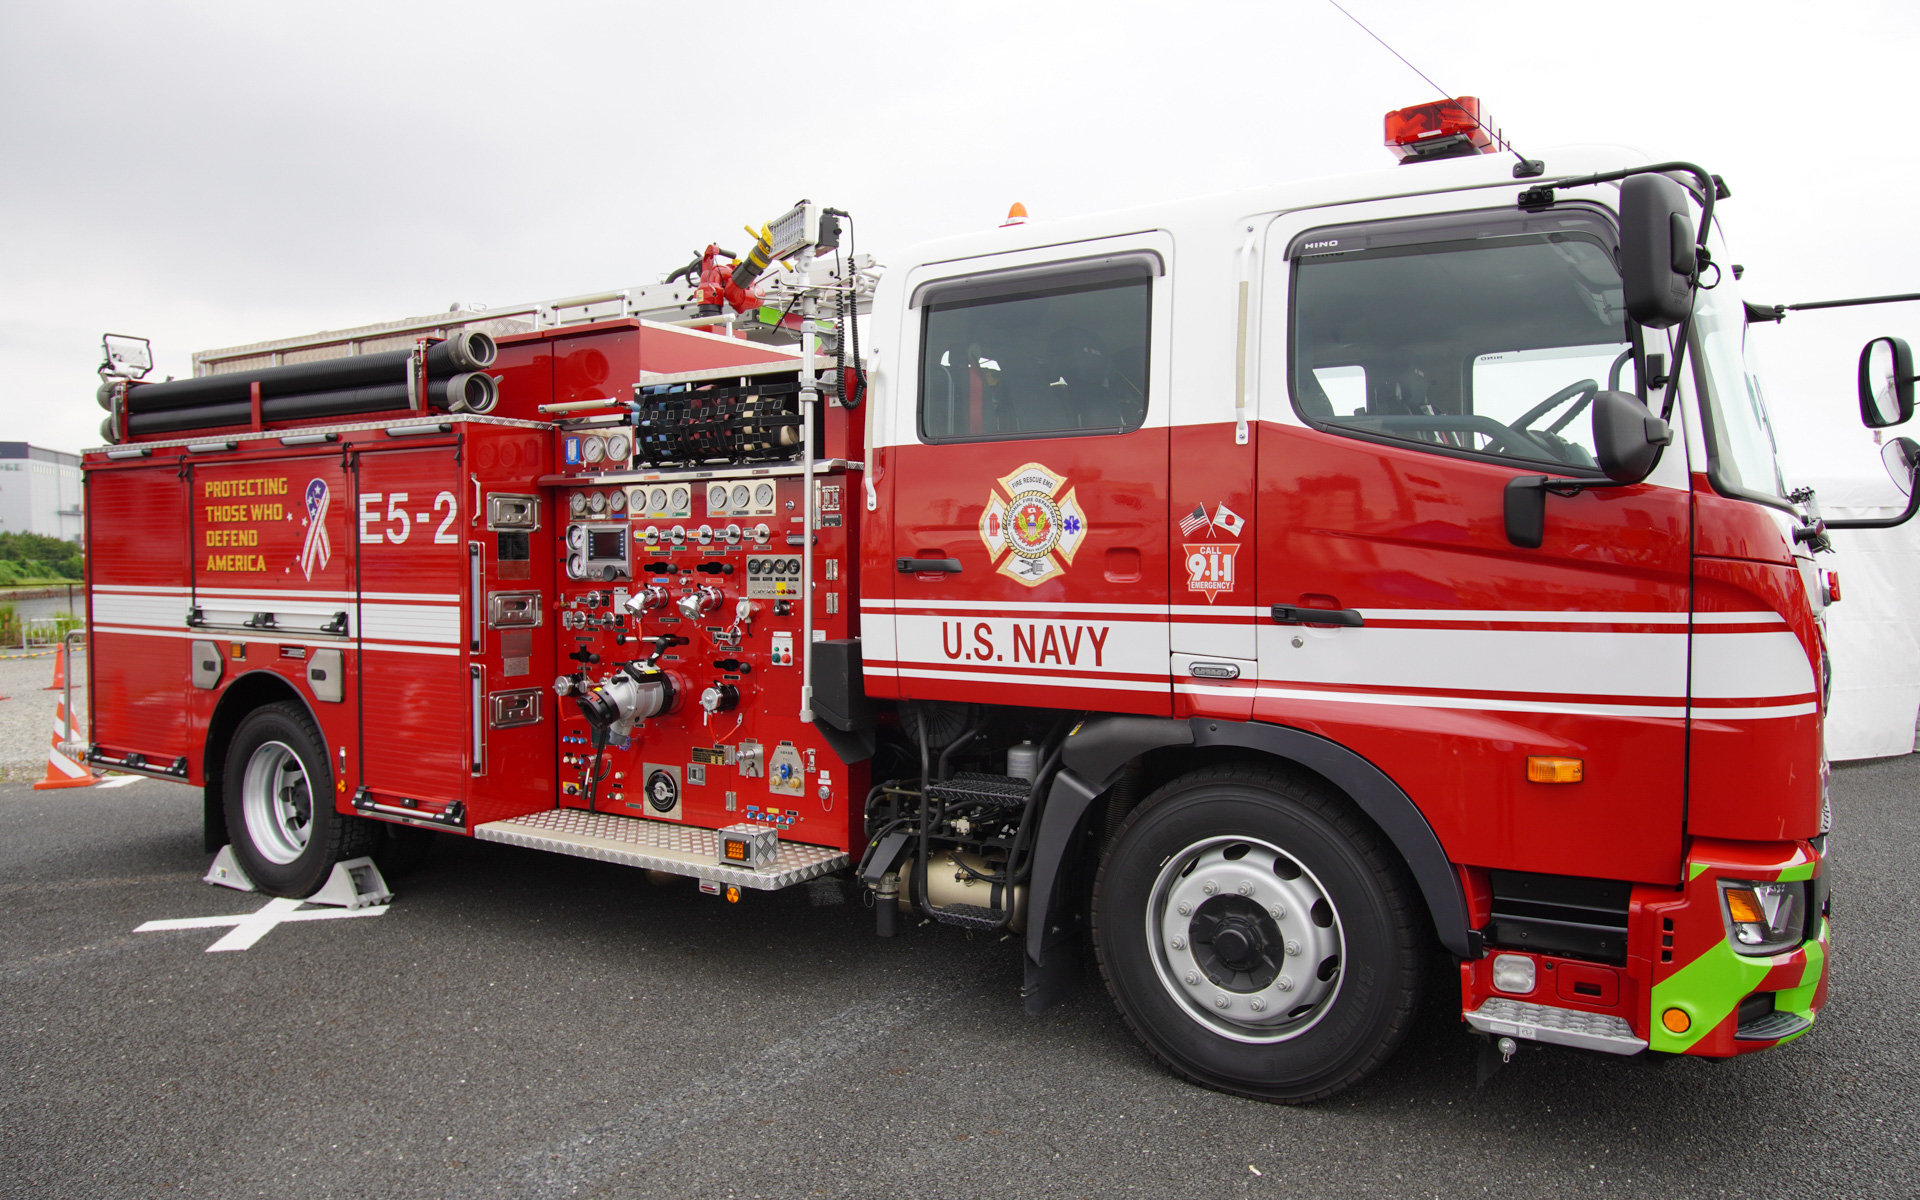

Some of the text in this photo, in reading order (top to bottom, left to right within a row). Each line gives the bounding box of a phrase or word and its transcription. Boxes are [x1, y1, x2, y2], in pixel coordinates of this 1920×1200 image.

[1304, 239, 1339, 250] HINO
[205, 477, 288, 498] PROTECTING
[1012, 476, 1053, 489] FIRE RESCUE EMS
[205, 503, 284, 522] THOSE WHO
[359, 491, 459, 544] E5-2
[1035, 498, 1057, 526] DEPARTMENT
[206, 530, 258, 547] DEFEND
[1199, 546, 1222, 555] CALL
[206, 554, 267, 572] AMERICA
[1191, 581, 1231, 589] EMERGENCY
[942, 621, 1110, 667] U.S. NAVY
